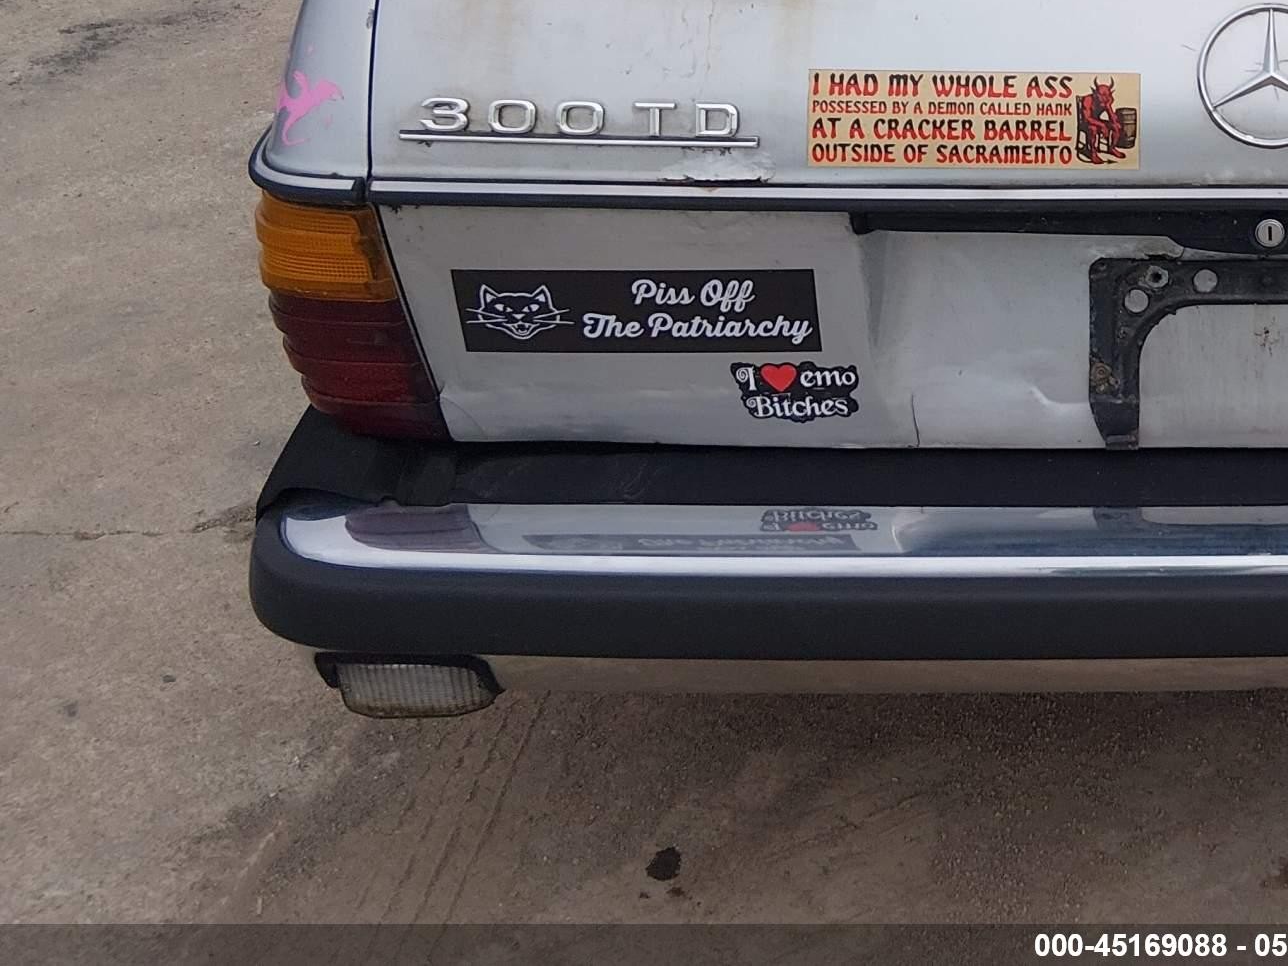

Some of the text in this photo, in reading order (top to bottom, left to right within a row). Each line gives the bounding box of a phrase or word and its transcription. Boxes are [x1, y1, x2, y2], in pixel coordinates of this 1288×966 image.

[812, 73, 1073, 99] I HAD MY WHOLE ASS
[420, 97, 741, 138] 300 TD
[812, 100, 1073, 116] POSSESSED BY A DEMON CALLED HANK
[812, 117, 1073, 141] AT A CRACKER BARREL
[812, 143, 1073, 165] OUTSIDE OF SACRAMENTO
[631, 278, 756, 313] Piss Off
[582, 312, 813, 345] The Patriarchy
[735, 366, 857, 391] I emo
[746, 395, 849, 418] Bitches
